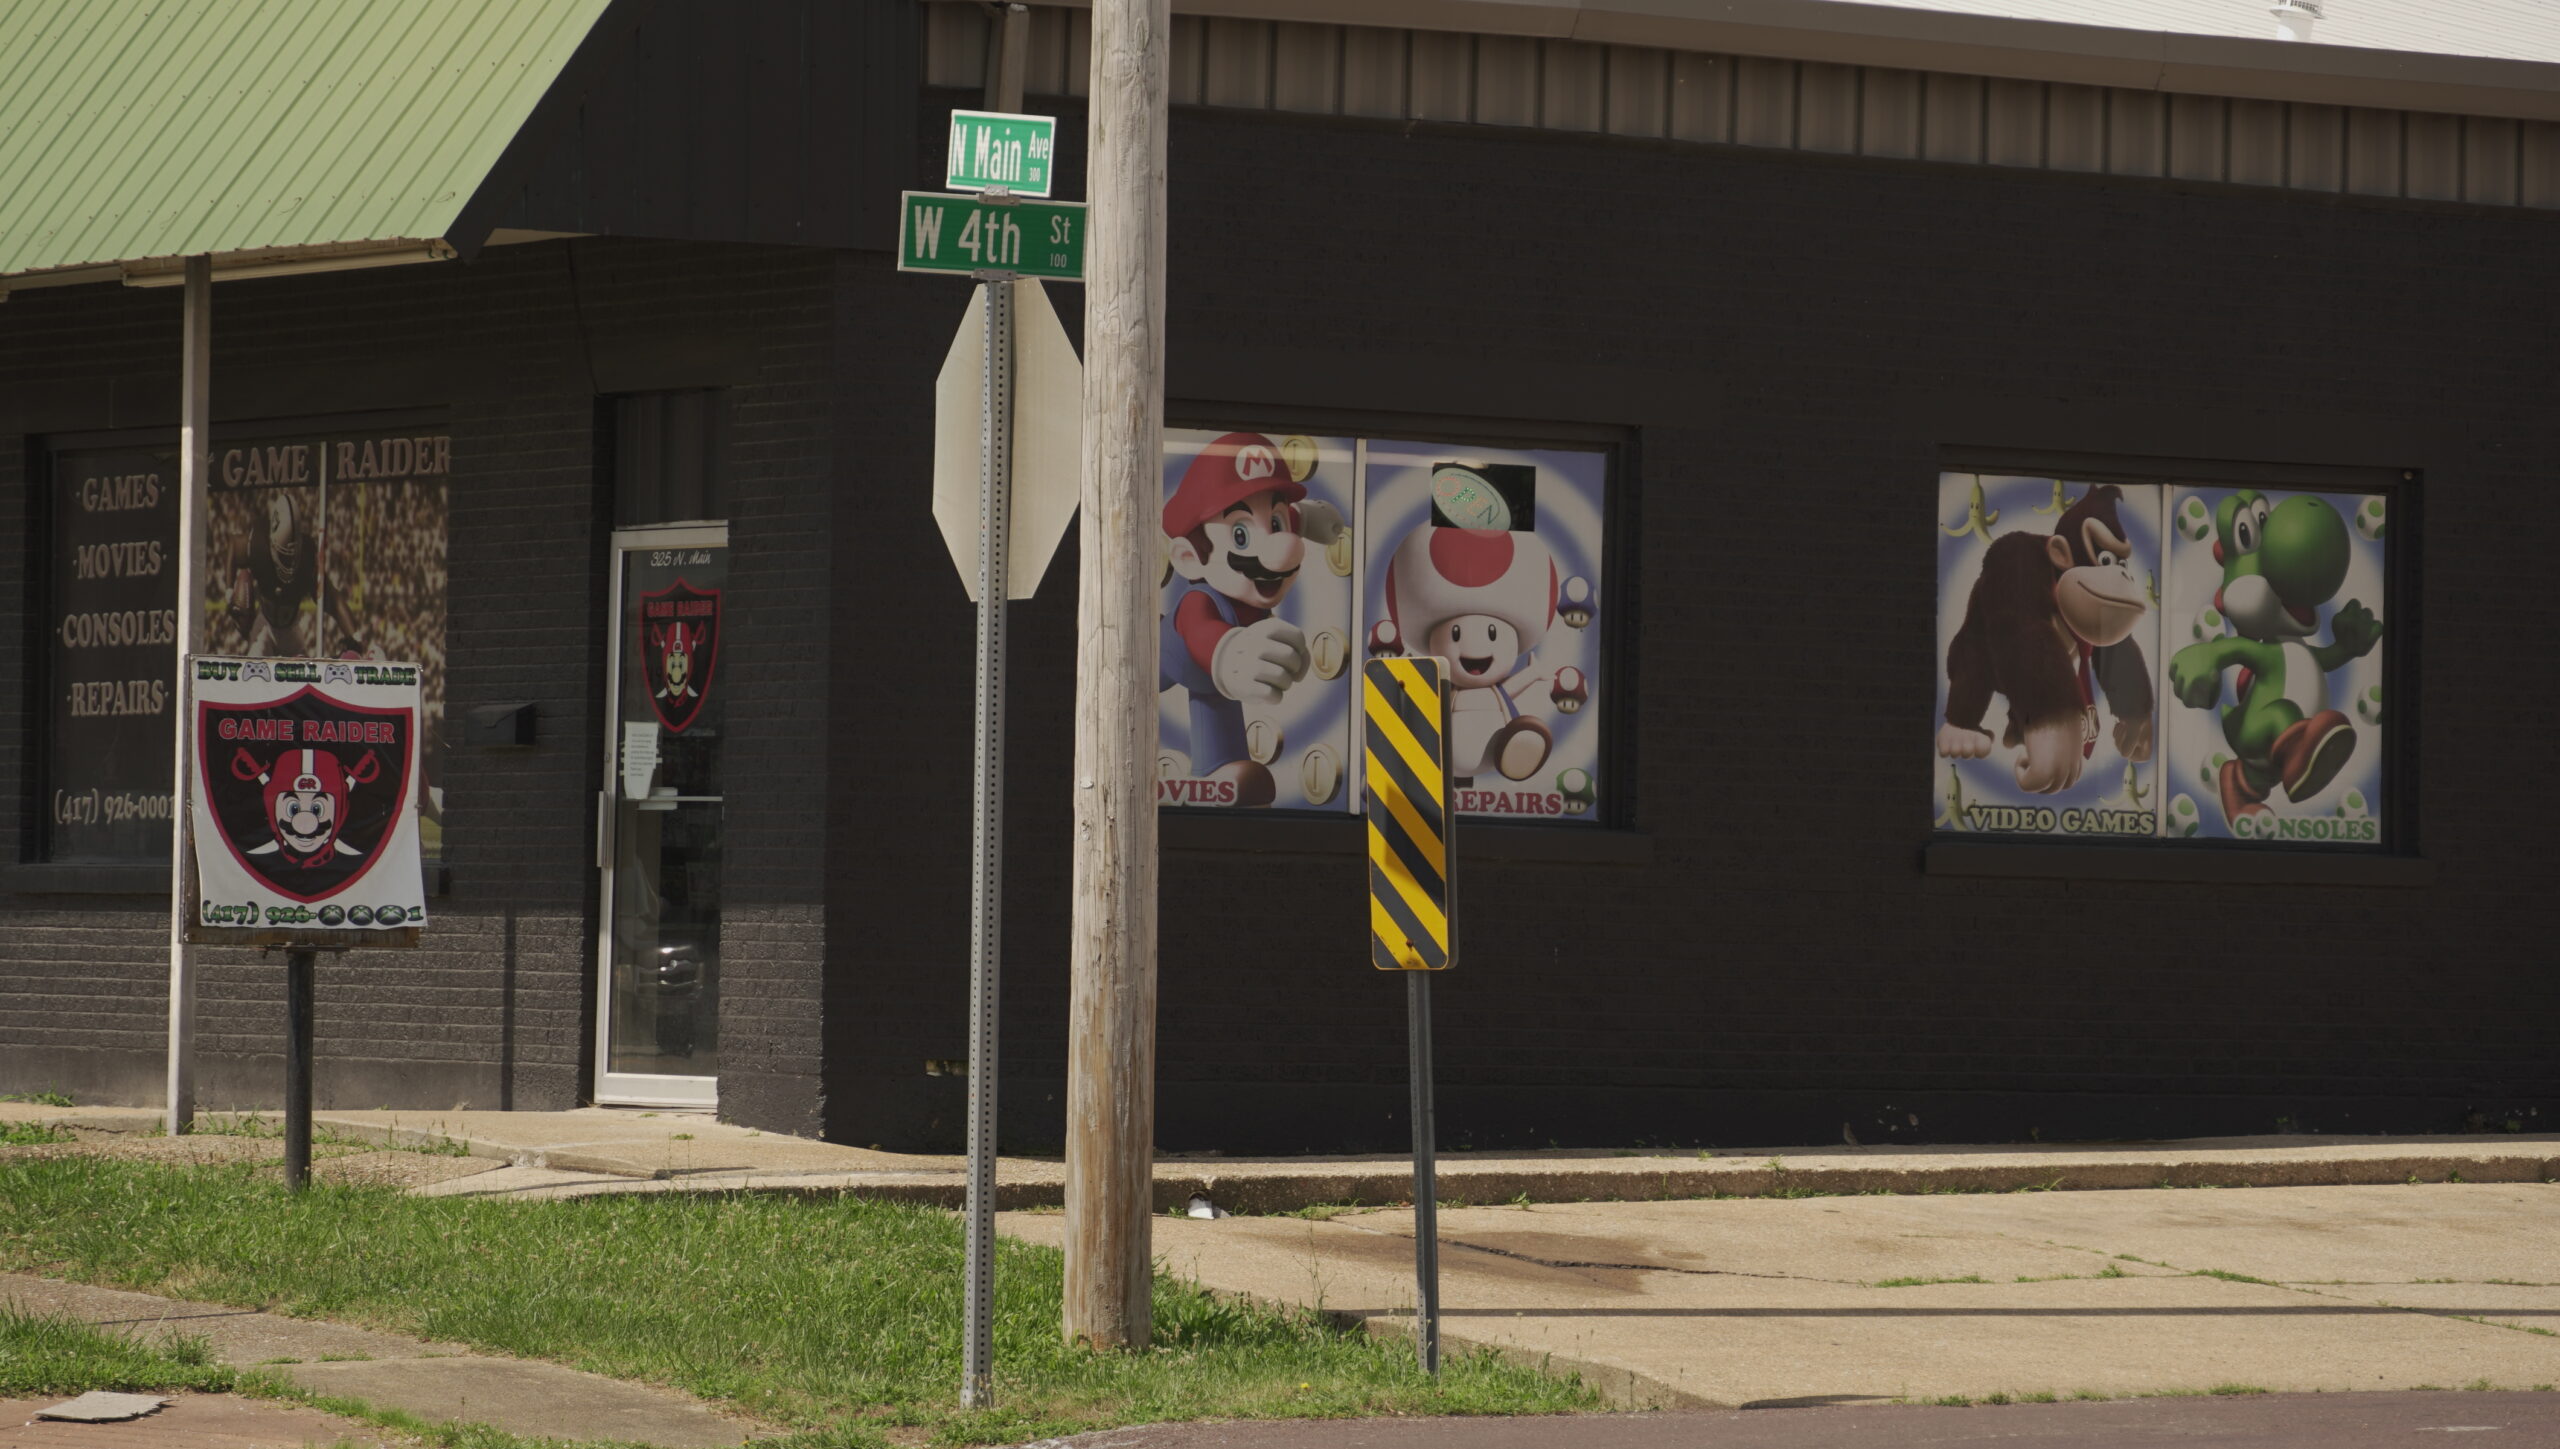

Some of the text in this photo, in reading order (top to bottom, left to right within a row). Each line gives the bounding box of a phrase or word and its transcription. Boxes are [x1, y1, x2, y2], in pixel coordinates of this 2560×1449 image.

[951, 124, 1049, 182] N Main Ave
[1028, 167, 1041, 182] 300
[914, 205, 1071, 265] W 4th St
[1050, 253, 1068, 268] 100
[222, 445, 310, 488] GAME
[1435, 476, 1500, 525] OPEN
[650, 551, 672, 567] 325
[689, 550, 711, 565] Main
[197, 661, 417, 686] BUY SELL TRADE
[218, 718, 396, 744] GAME RAIDER
[297, 778, 317, 790] GR
[54, 788, 99, 825] (417)
[1968, 806, 2157, 835] VIDEO GAMES
[202, 900, 259, 925] (417)
